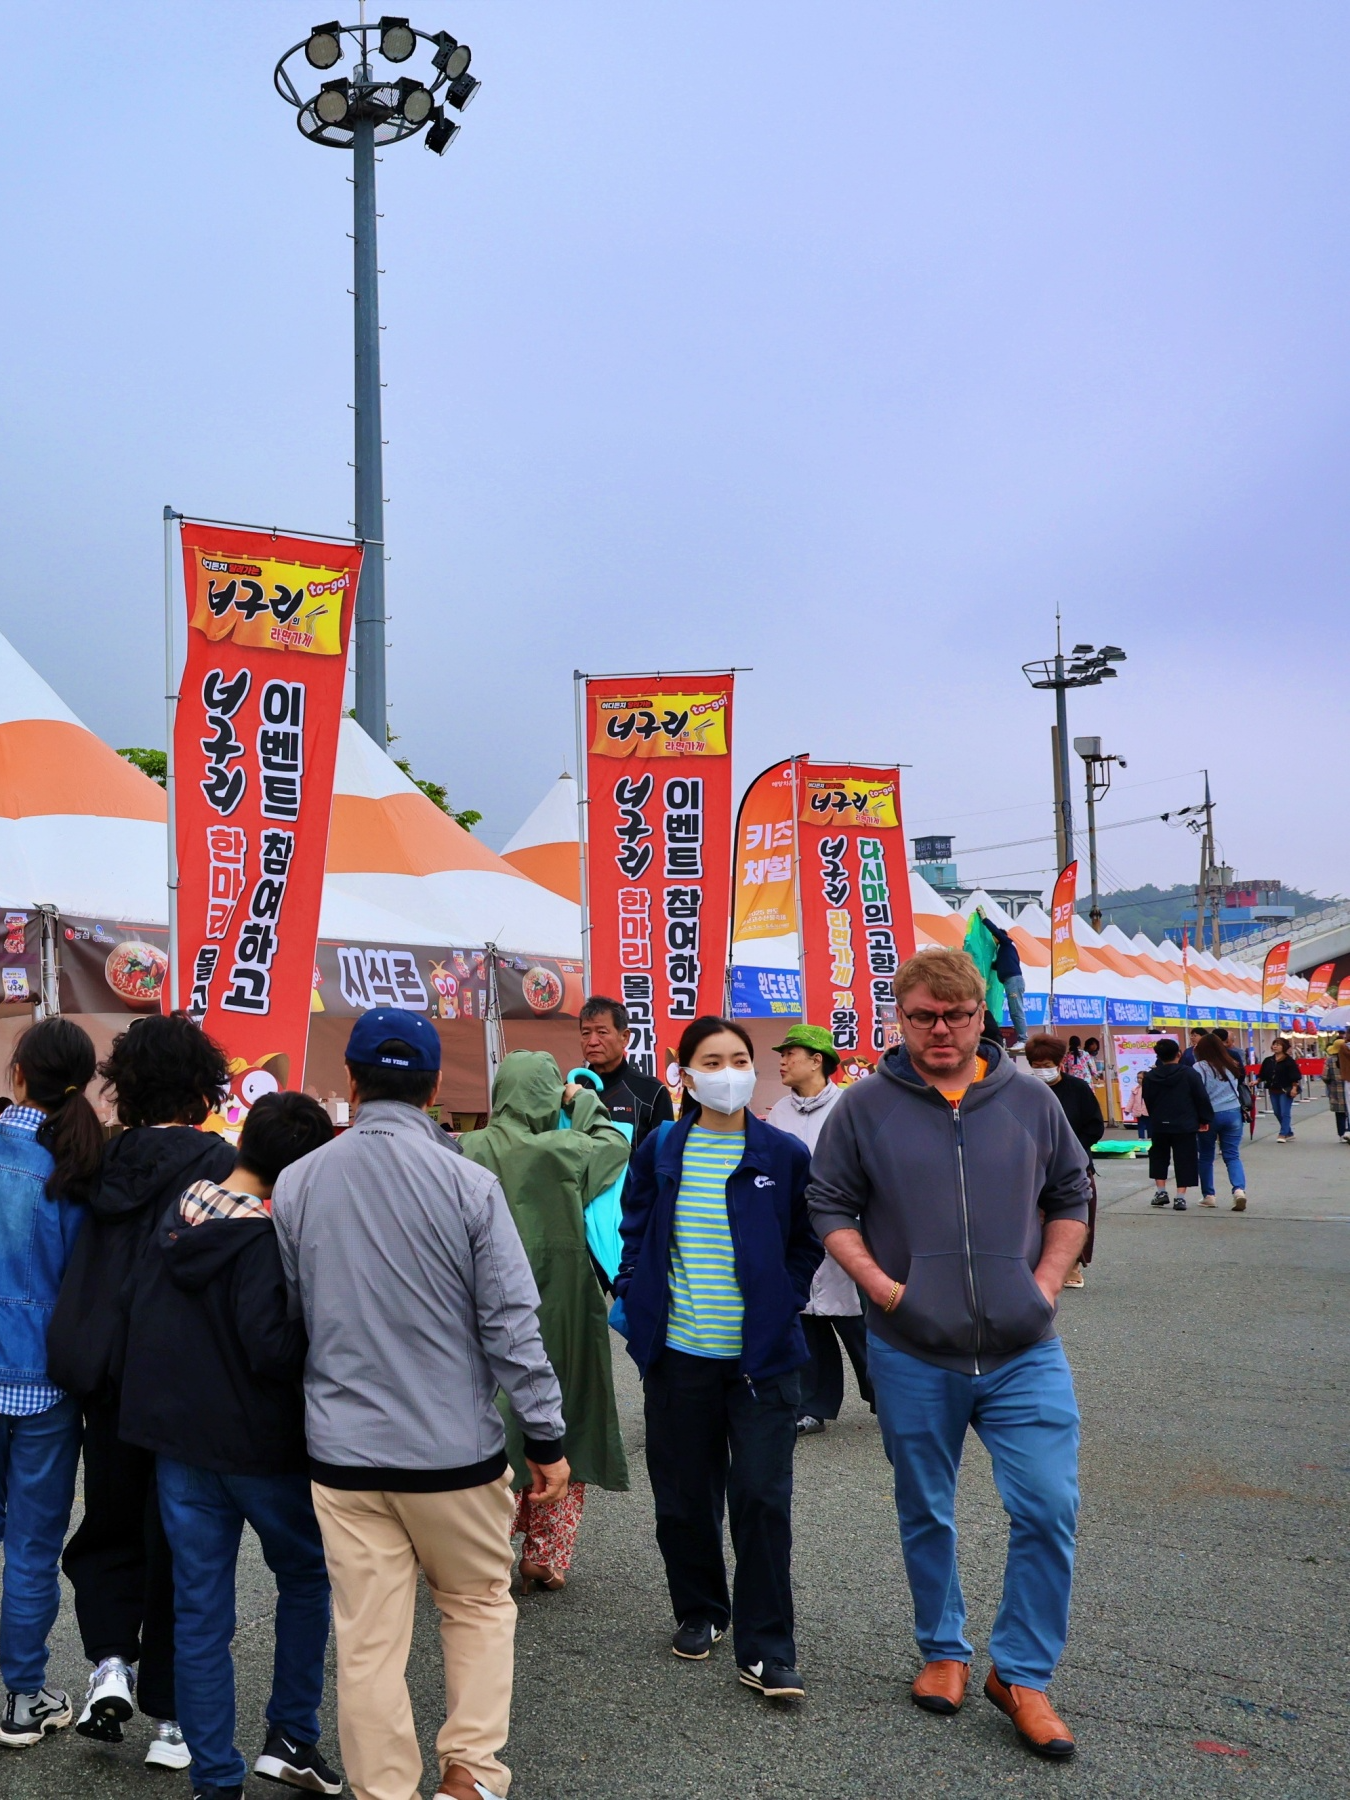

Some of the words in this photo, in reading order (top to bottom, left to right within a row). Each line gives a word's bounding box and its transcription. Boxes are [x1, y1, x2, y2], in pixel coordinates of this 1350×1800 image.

[208, 579, 304, 624] 너구리
[308, 574, 350, 597] to-go!
[270, 627, 313, 648] 라면가게
[607, 710, 689, 741] 너구리
[691, 695, 728, 715] to-go!
[202, 670, 248, 813] 너구리
[259, 682, 301, 818] 이벤트
[664, 741, 705, 752] 라면가게
[811, 791, 867, 813] 너구리
[869, 783, 896, 798] to-go!
[616, 775, 652, 879] 너구리
[664, 780, 700, 876] 이벤트
[745, 819, 793, 850] 키즈
[208, 828, 244, 937] 한마리
[742, 854, 792, 887] 체험
[820, 836, 848, 904] 너구리
[858, 839, 889, 925] 다시마의
[223, 831, 293, 1011] 참여하고
[618, 888, 649, 967] 한마리
[666, 888, 699, 1017] 참여하고
[869, 930, 897, 974] 고향
[342, 953, 426, 1007] 시식존
